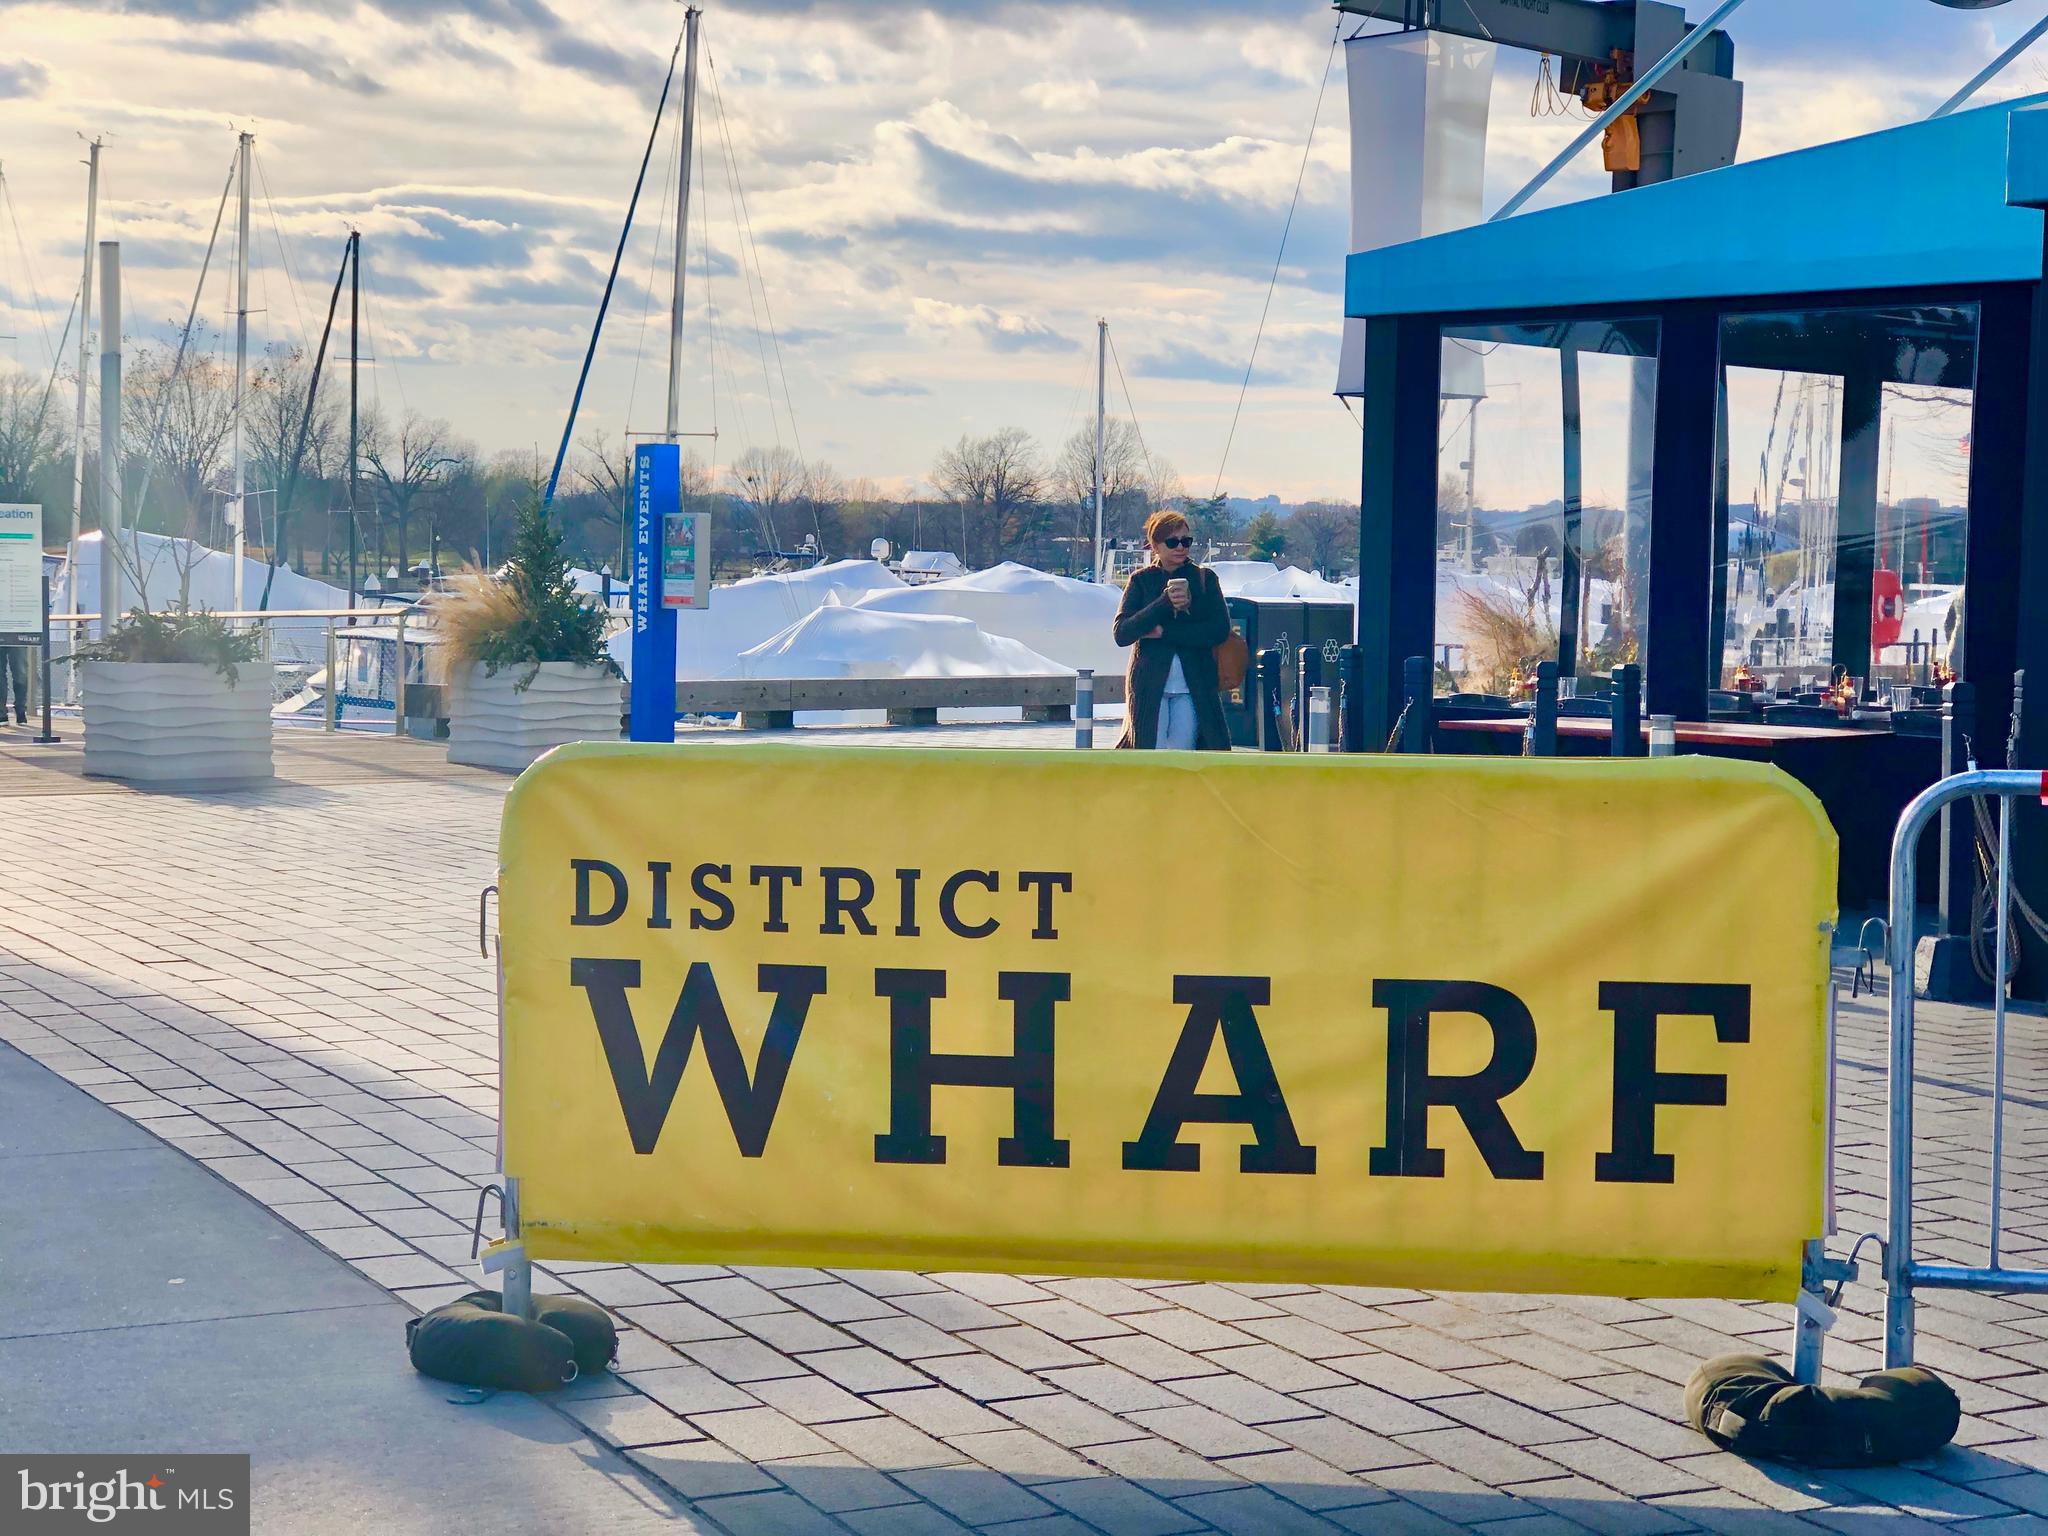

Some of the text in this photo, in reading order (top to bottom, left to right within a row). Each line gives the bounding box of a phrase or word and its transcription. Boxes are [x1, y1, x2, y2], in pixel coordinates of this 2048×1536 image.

[1536, 0, 1550, 15] CLUB
[637, 455, 650, 633] WHARF EVENTS
[570, 858, 1073, 940] DISTRICT
[570, 957, 1752, 1184] WHARF
